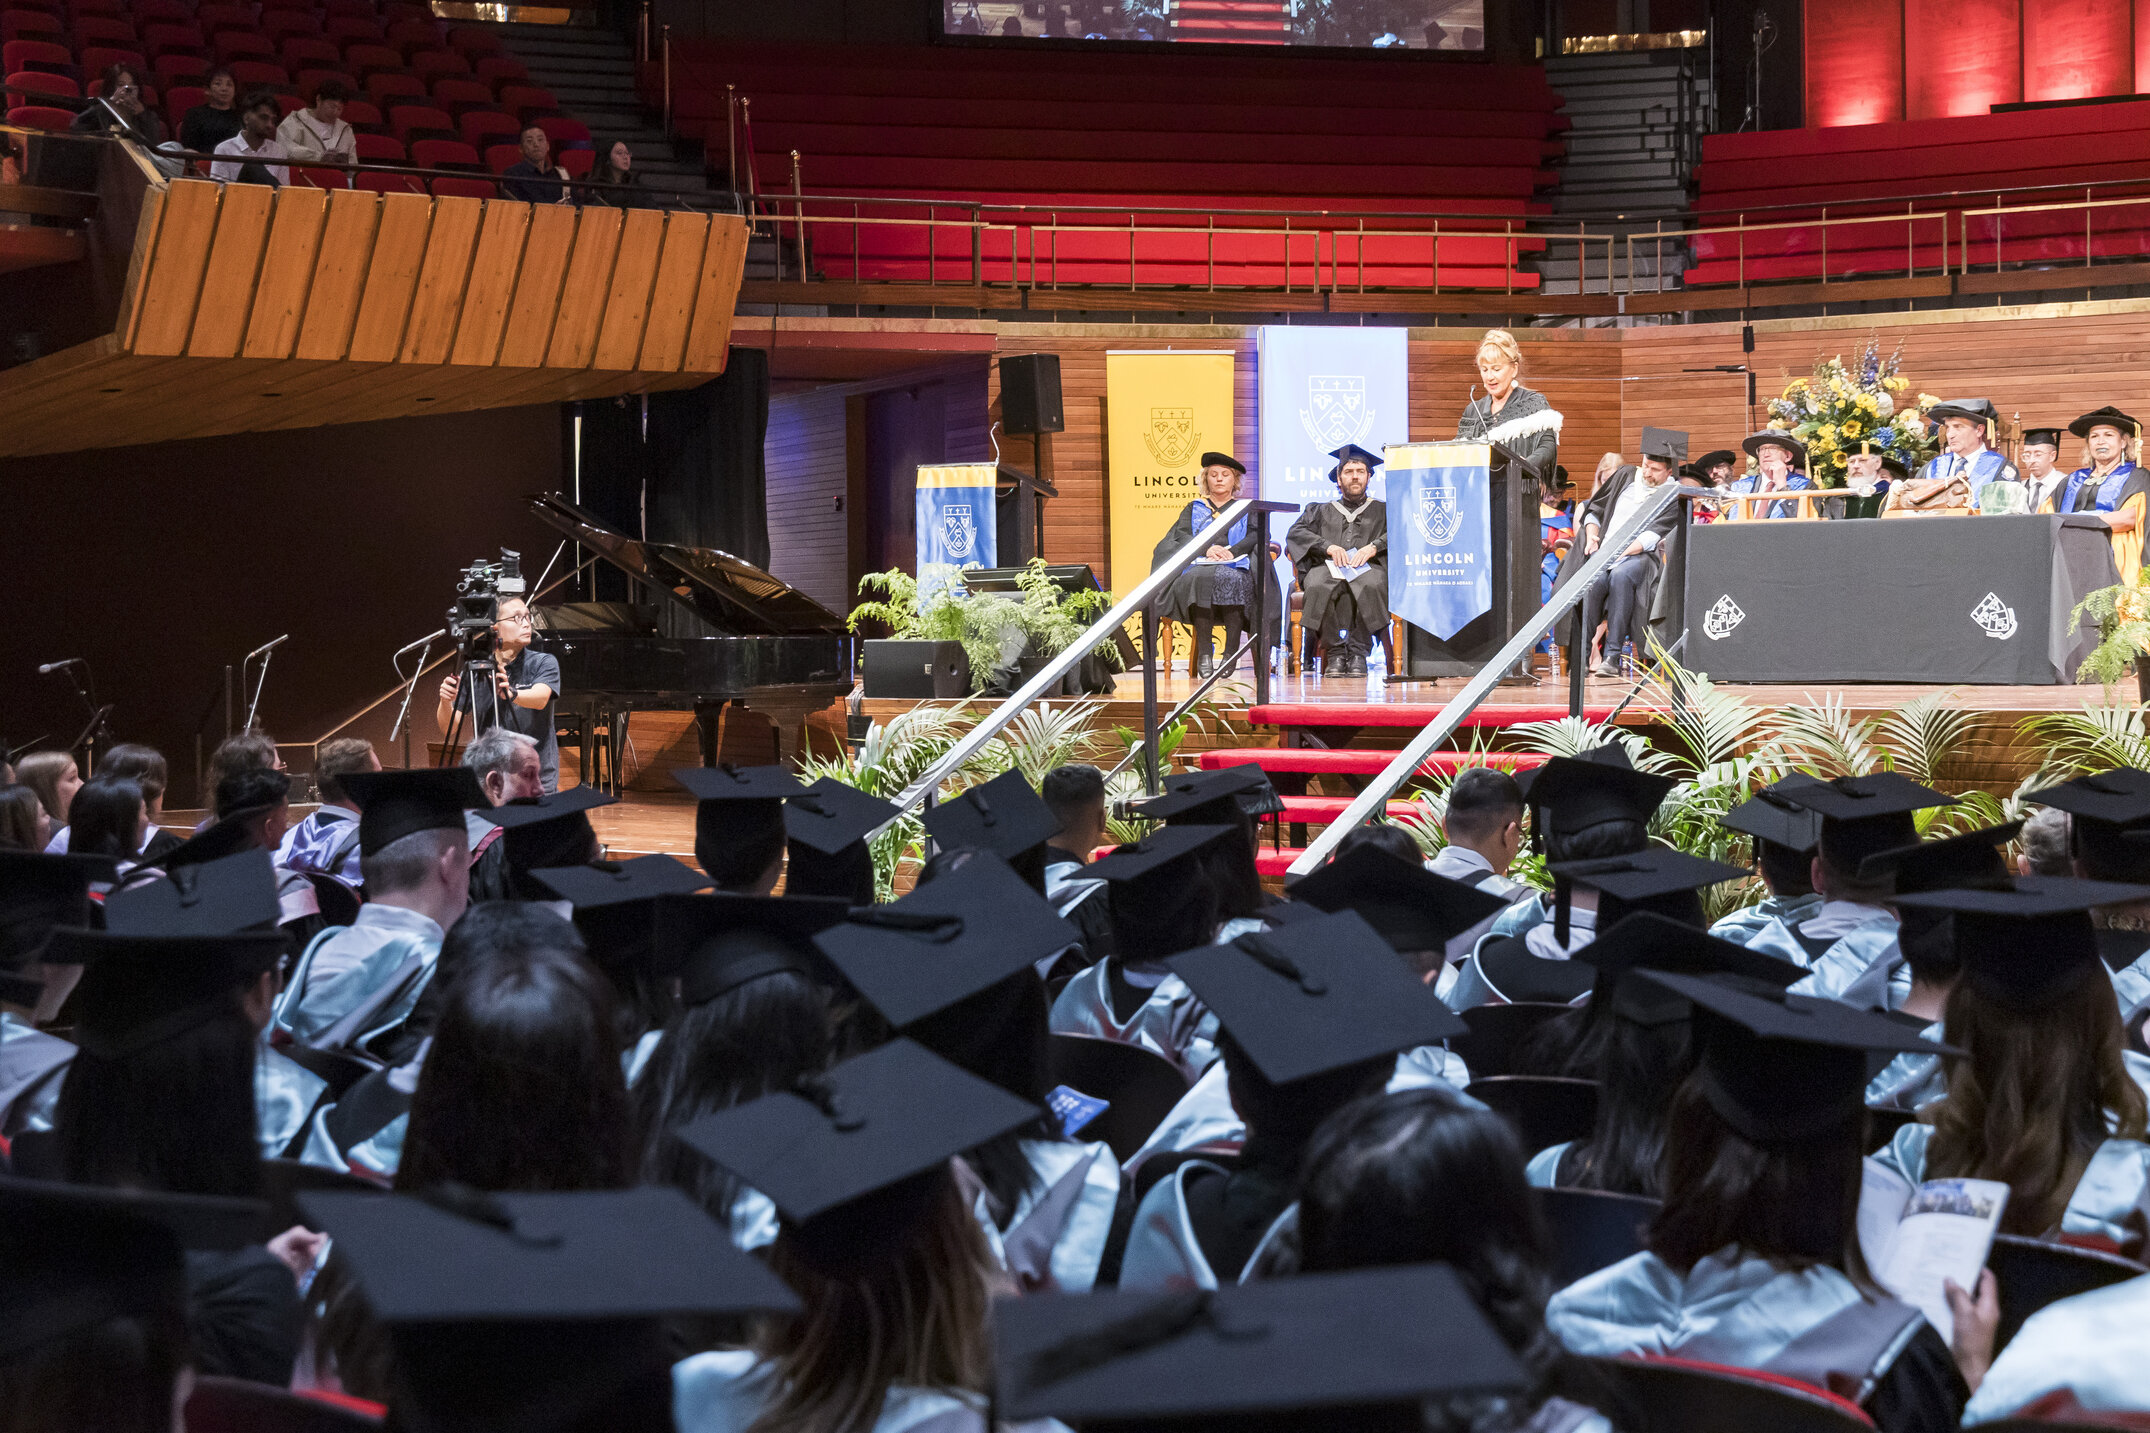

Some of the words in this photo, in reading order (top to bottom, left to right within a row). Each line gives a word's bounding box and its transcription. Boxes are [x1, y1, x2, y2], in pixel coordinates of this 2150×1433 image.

[1285, 467, 1386, 481] LINN
[1134, 476, 1199, 487] LINCOL
[1405, 553, 1474, 565] LINCOLN
